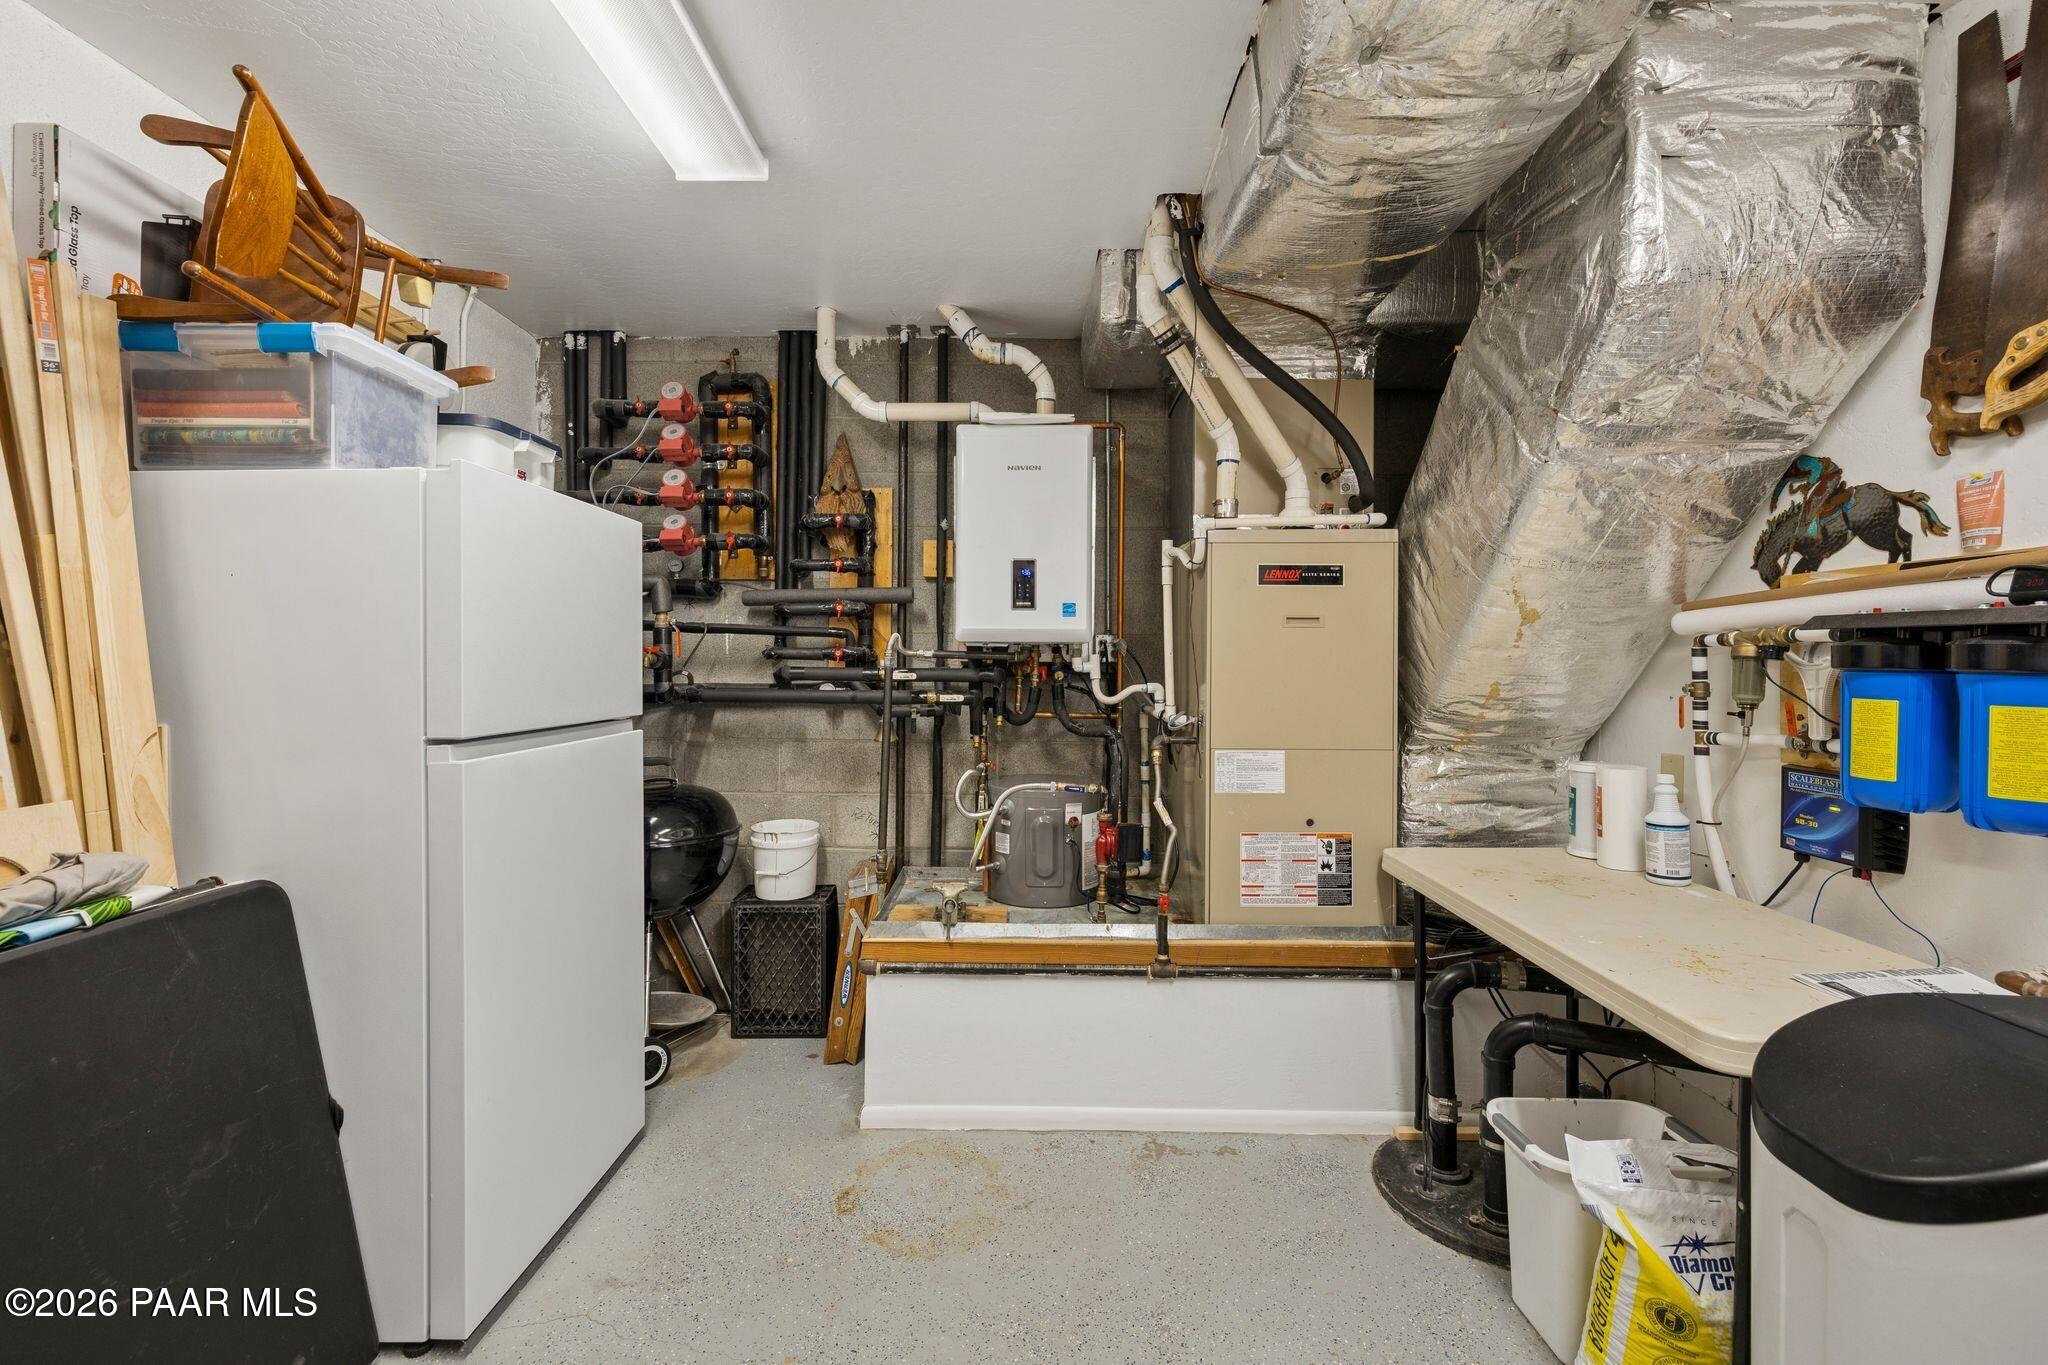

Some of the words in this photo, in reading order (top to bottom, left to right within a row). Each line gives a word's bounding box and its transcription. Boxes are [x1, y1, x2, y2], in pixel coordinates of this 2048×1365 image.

[69, 205, 81, 225] Top
[37, 236, 45, 249] Top
[68, 226, 78, 257] Glass
[80, 273, 91, 291] Tray
[1263, 569, 1302, 579] LENNOX
[1790, 774, 1841, 788] SCALEBLAST
[1671, 1216, 1717, 1227] SINCE
